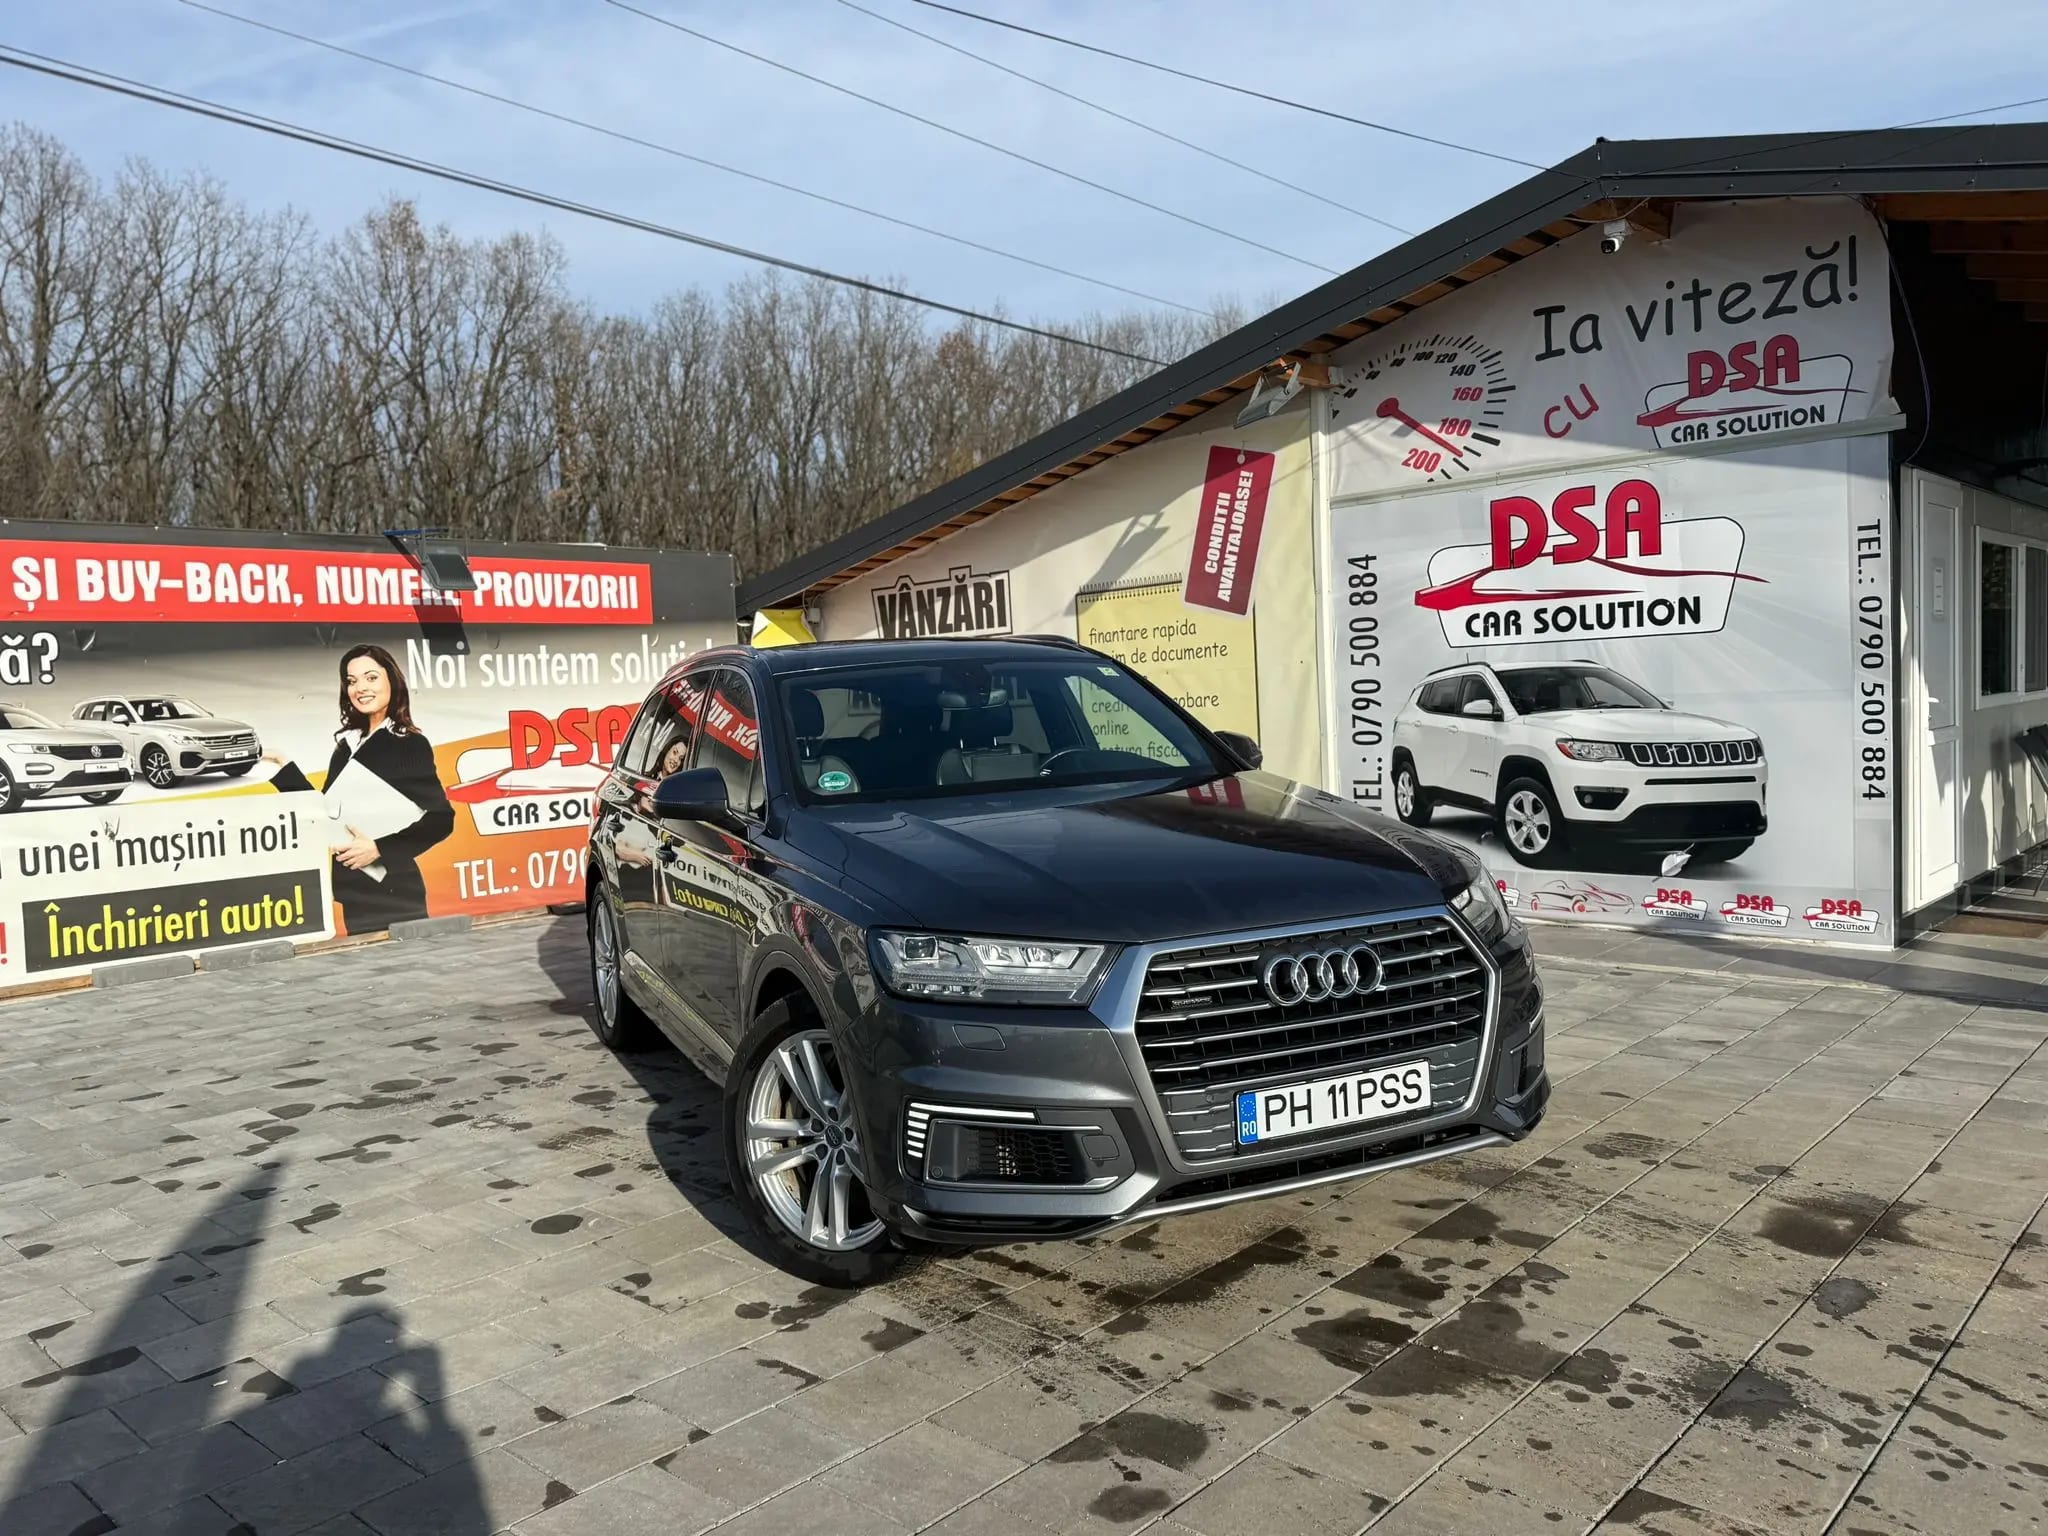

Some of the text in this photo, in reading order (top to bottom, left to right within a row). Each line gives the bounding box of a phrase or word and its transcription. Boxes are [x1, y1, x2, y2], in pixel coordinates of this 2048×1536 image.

[1533, 234, 1858, 362] Ia viteză!
[1434, 352, 1458, 365] 120
[1449, 363, 1476, 377] 140
[1687, 333, 1800, 400] DSA
[1451, 386, 1484, 401] 160
[1544, 383, 1599, 438] cu
[1437, 416, 1473, 437] 180
[1670, 404, 1826, 444] CAR SOLUTION
[1401, 447, 1442, 474] 200
[1217, 470, 1254, 603] AVANTAJOASE!
[1490, 478, 1662, 570] DSA
[11, 555, 60, 612] ȘI
[75, 558, 304, 607] BUY-BACK,
[473, 570, 639, 609] PROVIZORII
[1347, 554, 1378, 607] 884
[876, 573, 1007, 639] VÂNZĂRI
[1465, 595, 1701, 638] CAR SOLUTION
[1088, 619, 1197, 645] finantare rapida
[1349, 616, 1381, 667] 500
[405, 638, 468, 689] Noi
[479, 643, 599, 688] suntem
[1130, 648, 1148, 664] de
[1151, 642, 1229, 663] documente
[1857, 518, 1887, 801] TEL.: 0790 500 884
[1092, 719, 1130, 736] online
[1350, 678, 1383, 746] 0790
[492, 801, 540, 827] CAR
[18, 829, 100, 877] unei
[115, 819, 226, 872] mașini
[239, 811, 300, 855] noi!
[453, 858, 519, 900] TEL.:
[1656, 888, 1693, 906] DSA
[43, 885, 305, 958] Închirieri auto!
[1651, 908, 1700, 921] CAR SOLUTION
[1730, 915, 1782, 926] CAR SOLUTION
[1736, 893, 1774, 912] DSA
[1821, 898, 1862, 917] DSA
[1815, 921, 1871, 932] CAR SOLUTION
[1242, 1121, 1257, 1137] RO
[1264, 1088, 1313, 1132] PH
